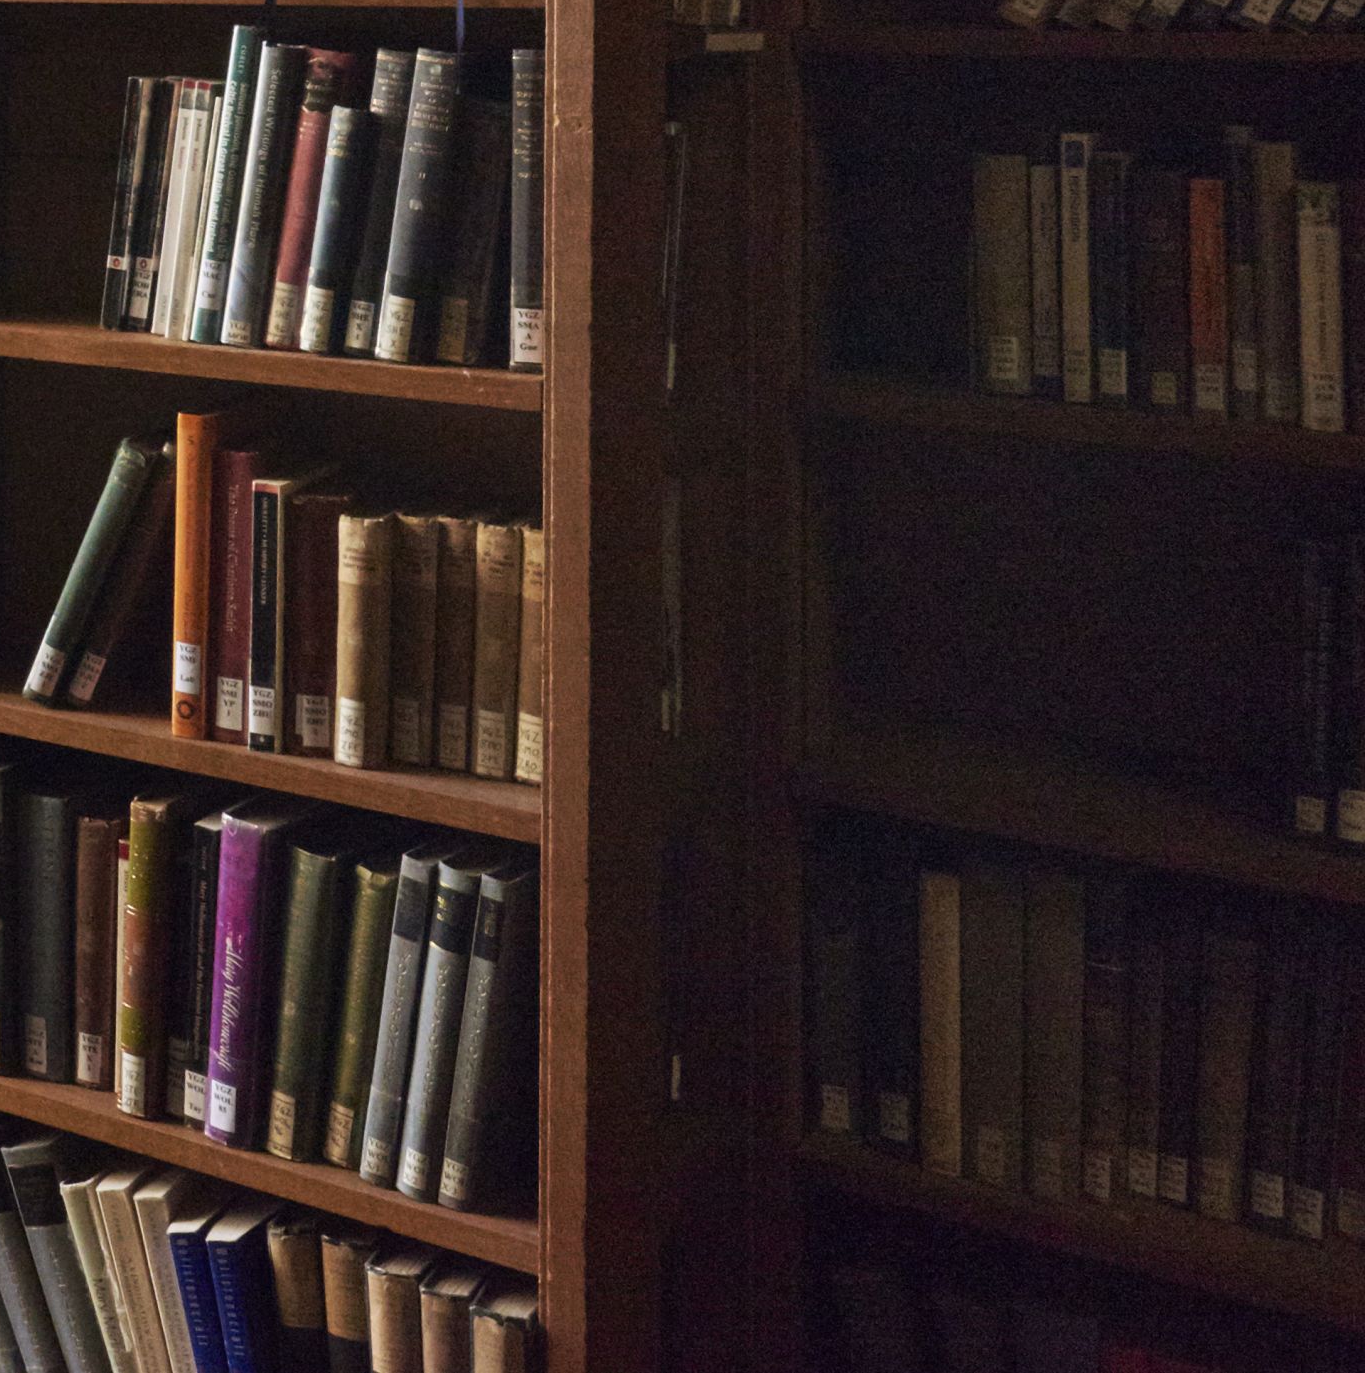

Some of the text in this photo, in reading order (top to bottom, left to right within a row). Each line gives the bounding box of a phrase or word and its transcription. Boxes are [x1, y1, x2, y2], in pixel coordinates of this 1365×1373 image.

[266, 69, 281, 112] Selected
[258, 117, 276, 161] Writings
[253, 179, 266, 218] Hannah
[247, 220, 259, 248] More
[518, 311, 539, 319] YGZ
[518, 322, 539, 330] SMA
[178, 644, 197, 653] YGZ
[220, 679, 238, 688] YGZ
[253, 689, 273, 699] YGZ
[253, 699, 272, 708] SMO
[217, 982, 242, 1072] Wollstonecraft
[215, 1083, 233, 1096] YGZ
[214, 1093, 233, 1106] WOL
